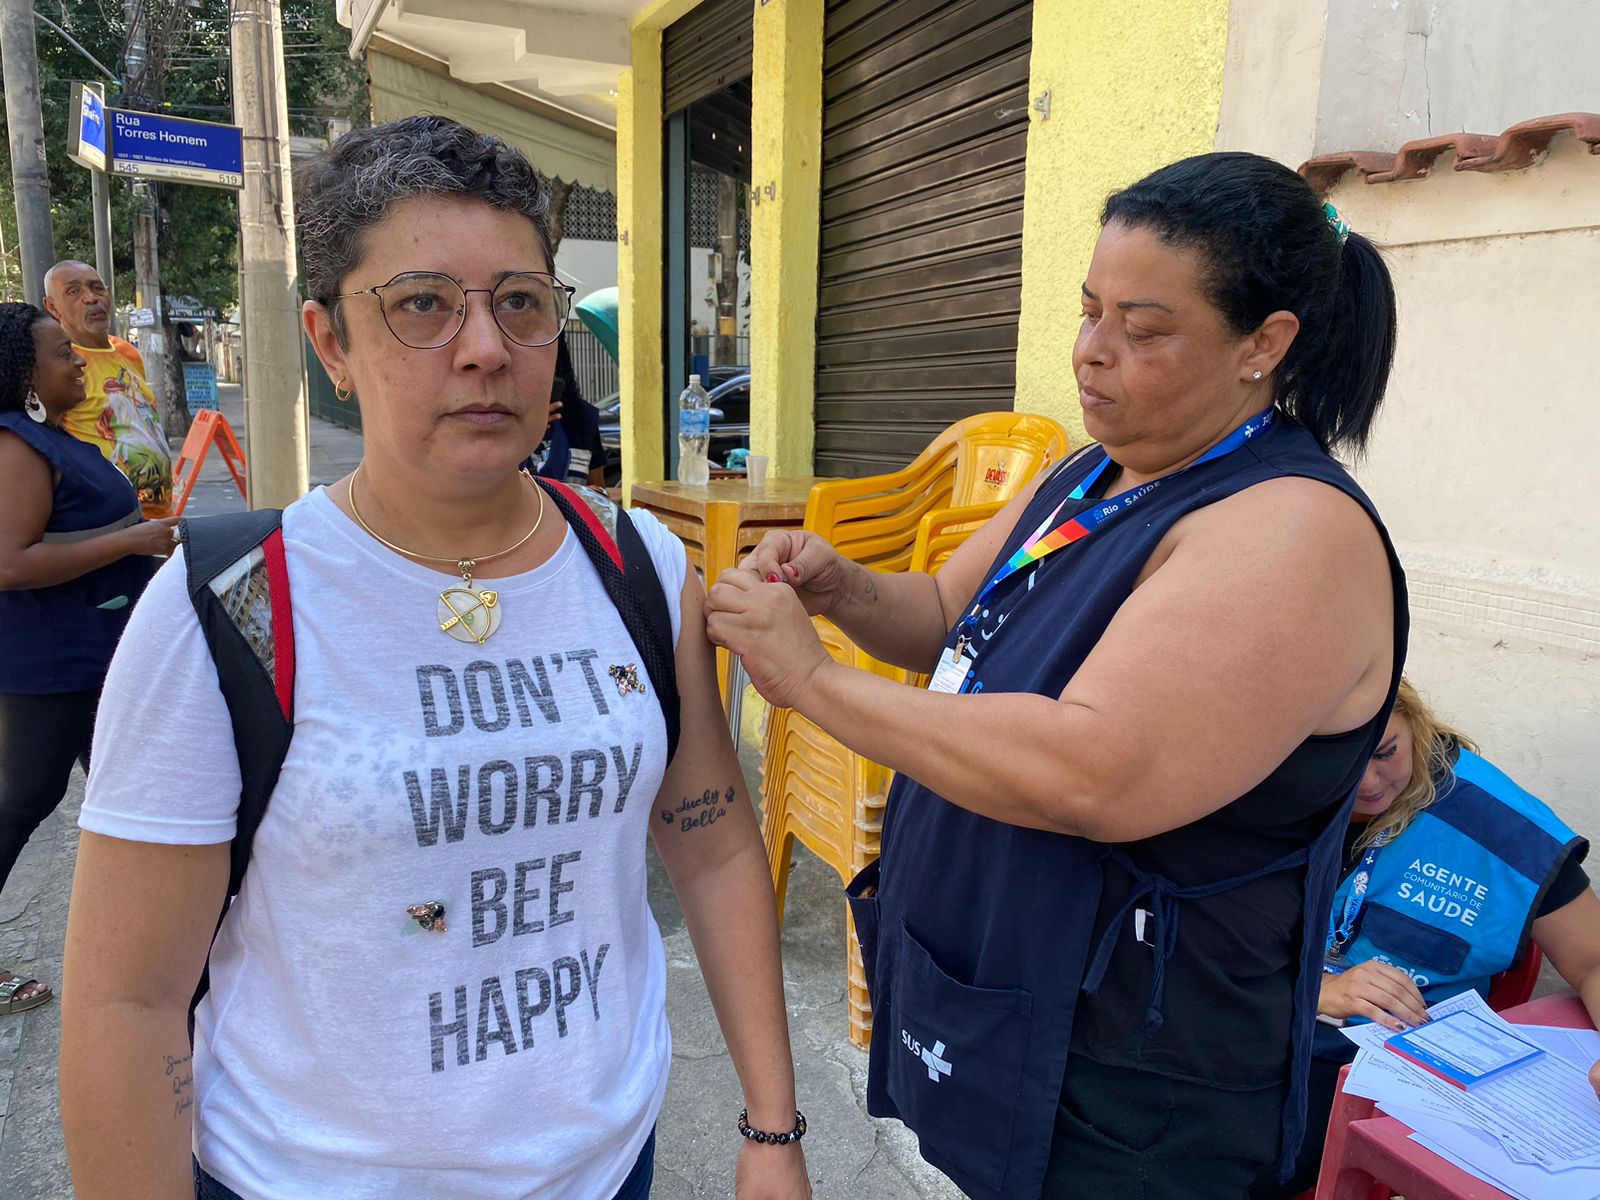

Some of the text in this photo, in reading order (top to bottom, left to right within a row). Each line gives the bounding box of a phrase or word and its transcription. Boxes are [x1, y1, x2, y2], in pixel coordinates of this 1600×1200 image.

[115, 113, 140, 126] Rua
[115, 125, 208, 147] Torres Homem
[119, 162, 140, 174] 545
[218, 174, 238, 185] 519
[1101, 480, 1162, 517] Rio SAÚDE
[402, 741, 644, 848] WORRY
[676, 789, 720, 813] Lucky
[680, 806, 728, 833] Bella
[1403, 871, 1484, 911] COMUNITÁRIO DE
[1408, 858, 1489, 901] AGENTE
[470, 850, 583, 949] BEE
[1397, 882, 1479, 927] SAÚDE
[427, 943, 611, 1074] HAPPY
[901, 1029, 921, 1057] SUS
